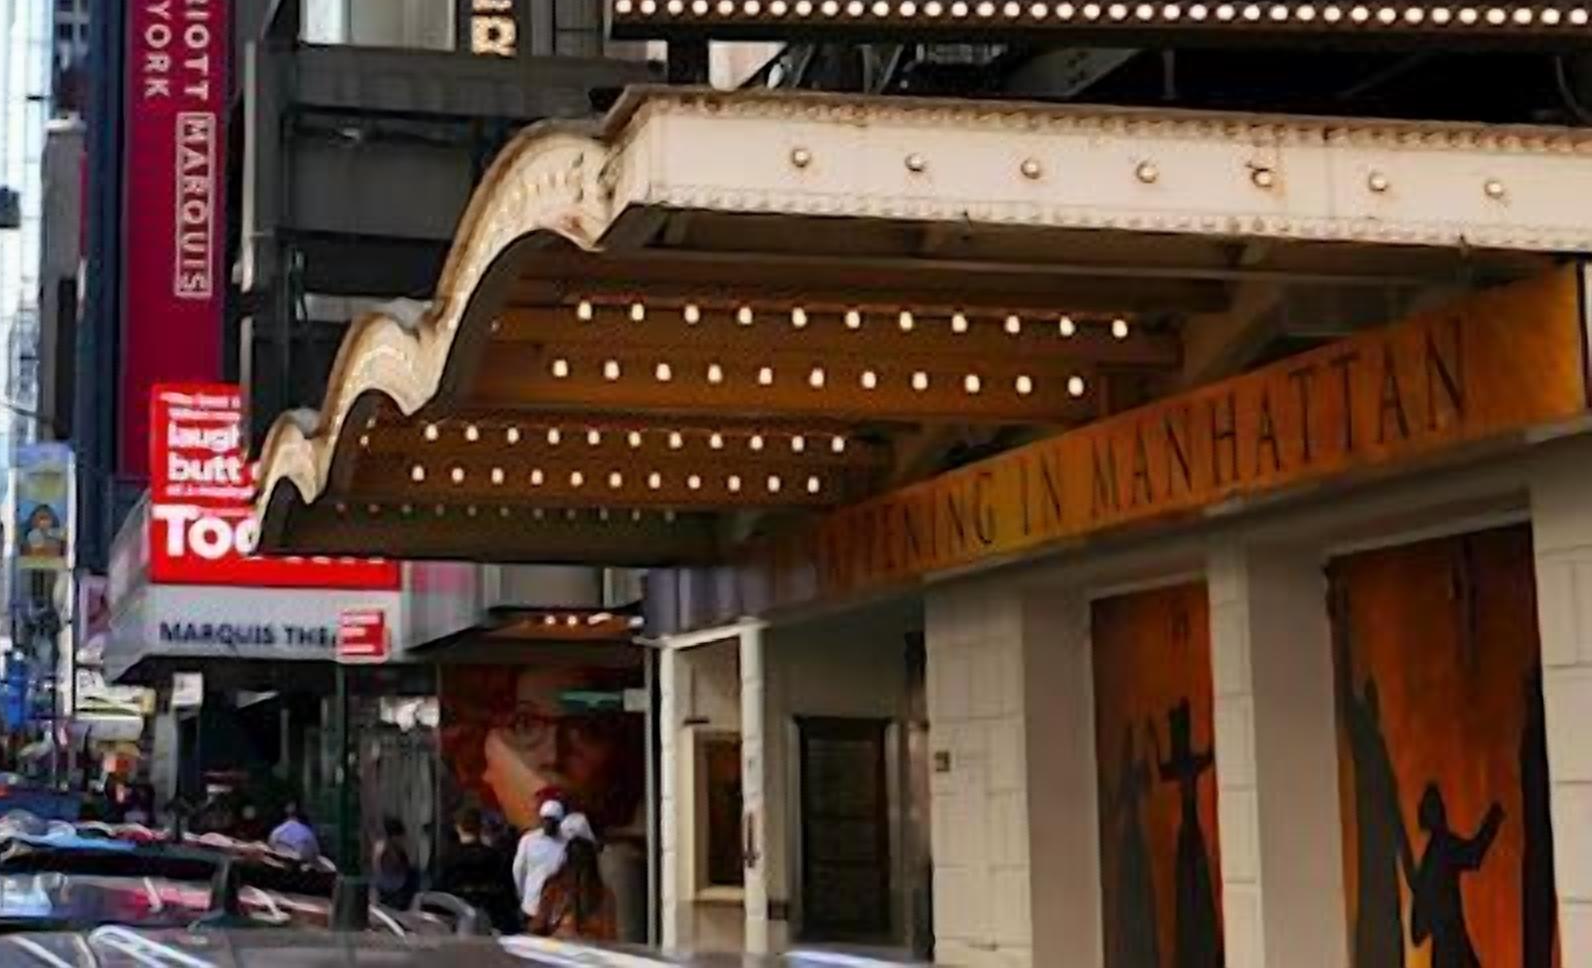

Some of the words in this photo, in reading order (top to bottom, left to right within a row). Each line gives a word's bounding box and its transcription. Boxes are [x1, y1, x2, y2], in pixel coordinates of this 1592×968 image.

[143, 0, 172, 98] YORK
[180, 114, 211, 294] MARQUIS
[168, 451, 244, 485] butt
[1020, 452, 1066, 538] IN
[1090, 316, 1468, 524] MANHATTAN
[159, 620, 276, 646] MARQUIS
[280, 626, 339, 648] THE
